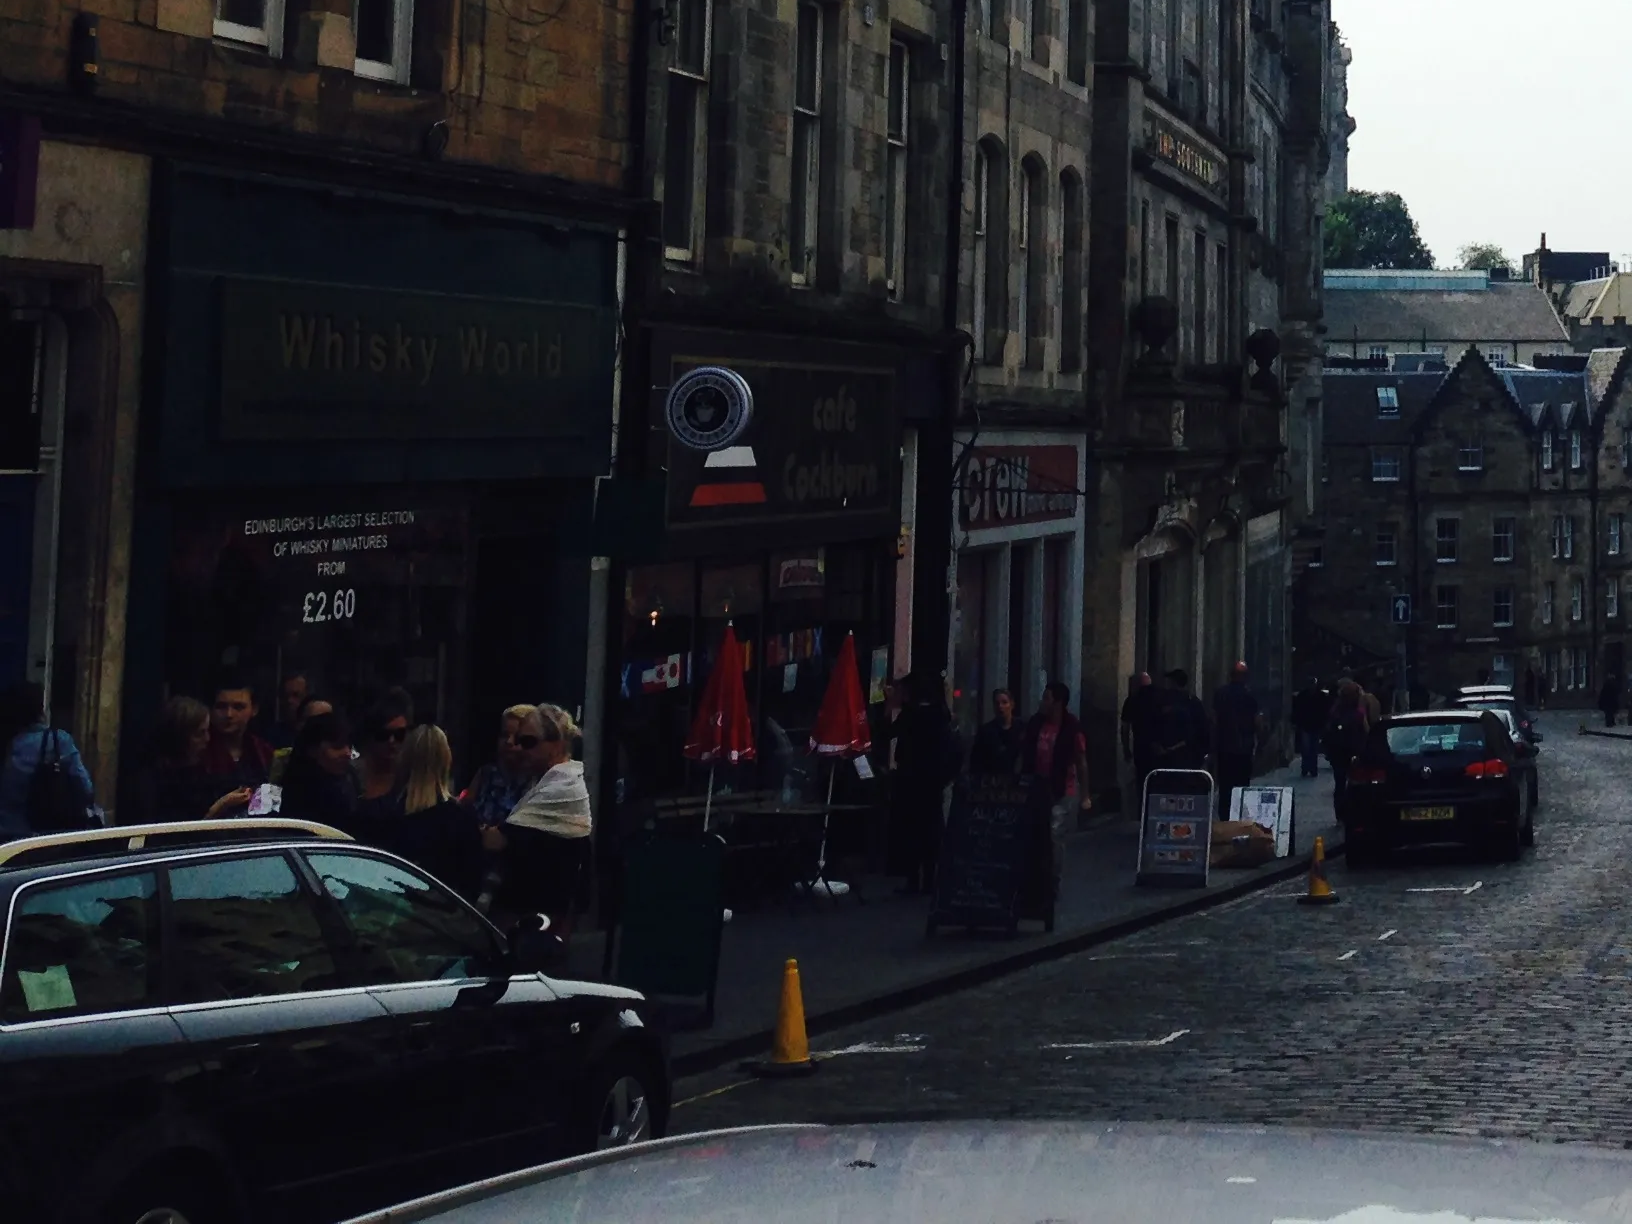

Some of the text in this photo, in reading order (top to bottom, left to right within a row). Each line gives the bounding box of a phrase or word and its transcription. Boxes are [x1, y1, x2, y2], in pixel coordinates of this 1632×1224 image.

[280, 313, 563, 384] Whisky World
[812, 383, 857, 432] cafe
[782, 449, 879, 502] Cockburn
[963, 456, 1029, 522] crew
[244, 510, 415, 536] EDINBURGH'S LARGEST SELECTION
[273, 534, 389, 557] OF WHISKY MINIATURES
[317, 561, 346, 576] FROM
[302, 588, 356, 624] £2.60
